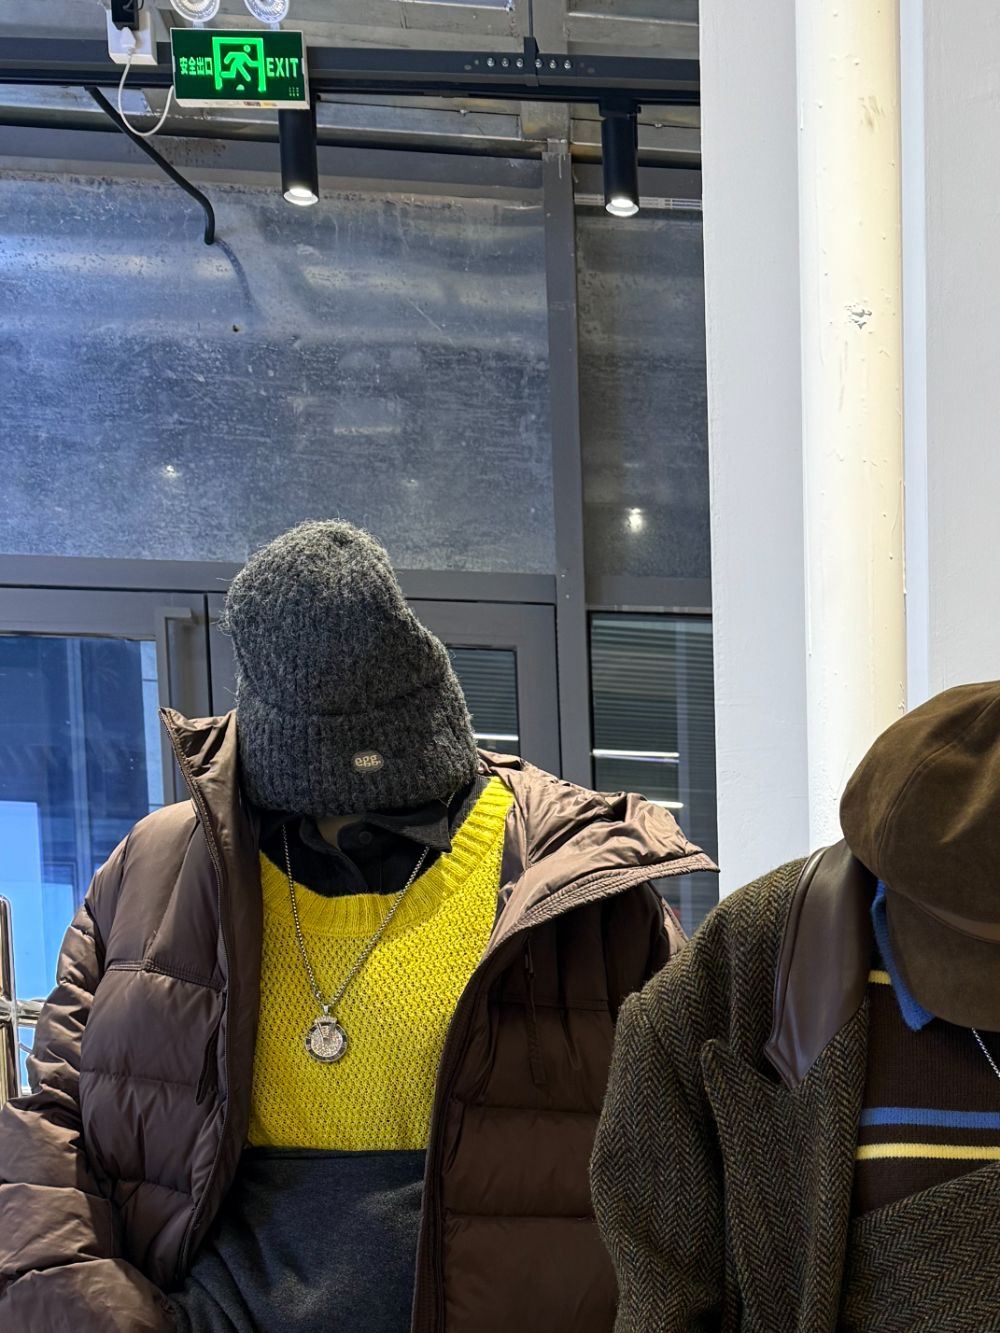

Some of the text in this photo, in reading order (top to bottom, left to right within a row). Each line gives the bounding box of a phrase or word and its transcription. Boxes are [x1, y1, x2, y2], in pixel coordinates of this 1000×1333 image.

[179, 56, 213, 76] 安全出口
[266, 57, 299, 78] EXIT
